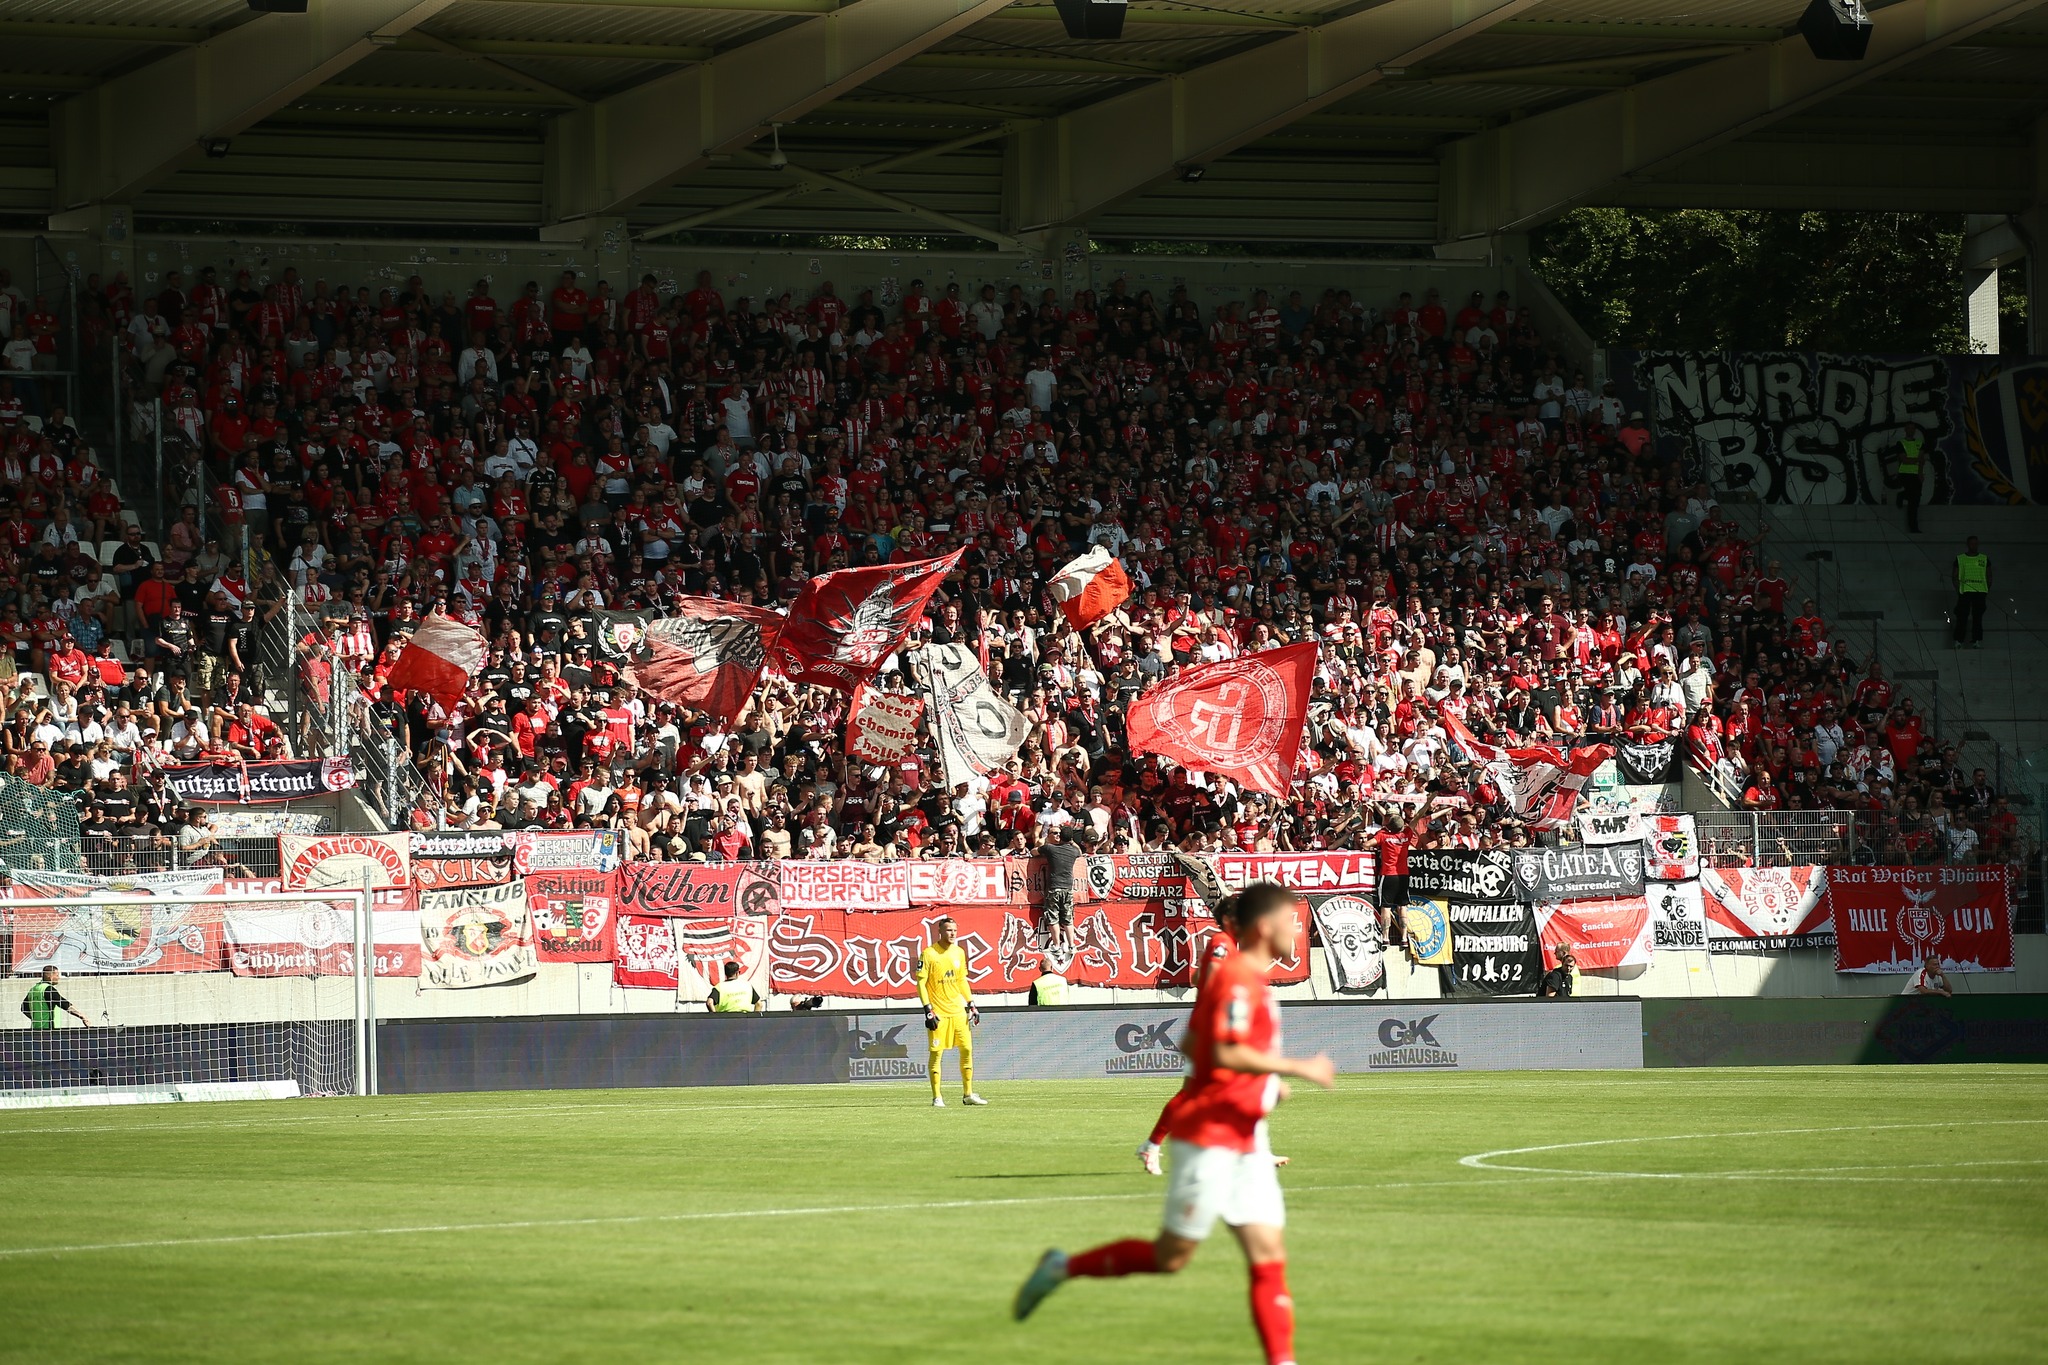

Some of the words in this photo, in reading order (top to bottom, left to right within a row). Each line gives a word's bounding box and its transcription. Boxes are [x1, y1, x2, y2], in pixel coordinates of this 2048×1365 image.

[1653, 358, 1813, 422] NUR
[1822, 363, 1940, 431] DIE
[410, 832, 503, 853] Petersberg
[536, 838, 593, 854] SEKTION
[289, 838, 410, 888] MARATHONTOR
[528, 853, 602, 867] WEISSENFELS
[1129, 855, 1176, 866] SEKTION
[1487, 851, 1513, 869] HFC
[1543, 850, 1599, 881] GATE
[1599, 847, 1621, 879] A
[1224, 857, 1375, 889] SURREALE
[1833, 868, 1867, 883] Rot
[1938, 867, 2001, 885] Phönix
[620, 867, 731, 911] Köthen
[1123, 882, 1184, 898] SÜDHARZ
[1548, 882, 1565, 893] No
[1565, 880, 1622, 892] Surrender
[420, 882, 524, 910] FANCLUB
[584, 899, 603, 907] HFC
[1451, 904, 1524, 923] DOMFALKEN
[1849, 908, 1889, 932] HALLE
[1953, 906, 1994, 934] LUJA
[1910, 910, 1929, 918] HFC
[1455, 934, 1528, 952] MERSEBURG
[1654, 930, 1704, 946] BANDE
[1709, 939, 1768, 952] GEKOMMEN
[1770, 938, 1787, 949] UM
[1789, 937, 1805, 949] ZU
[1114, 1017, 1179, 1052] G&K
[1377, 1013, 1441, 1048] G&K
[1105, 1051, 1186, 1071] INNENAUSBA
[1368, 1048, 1458, 1065] INNENAUSBAU
